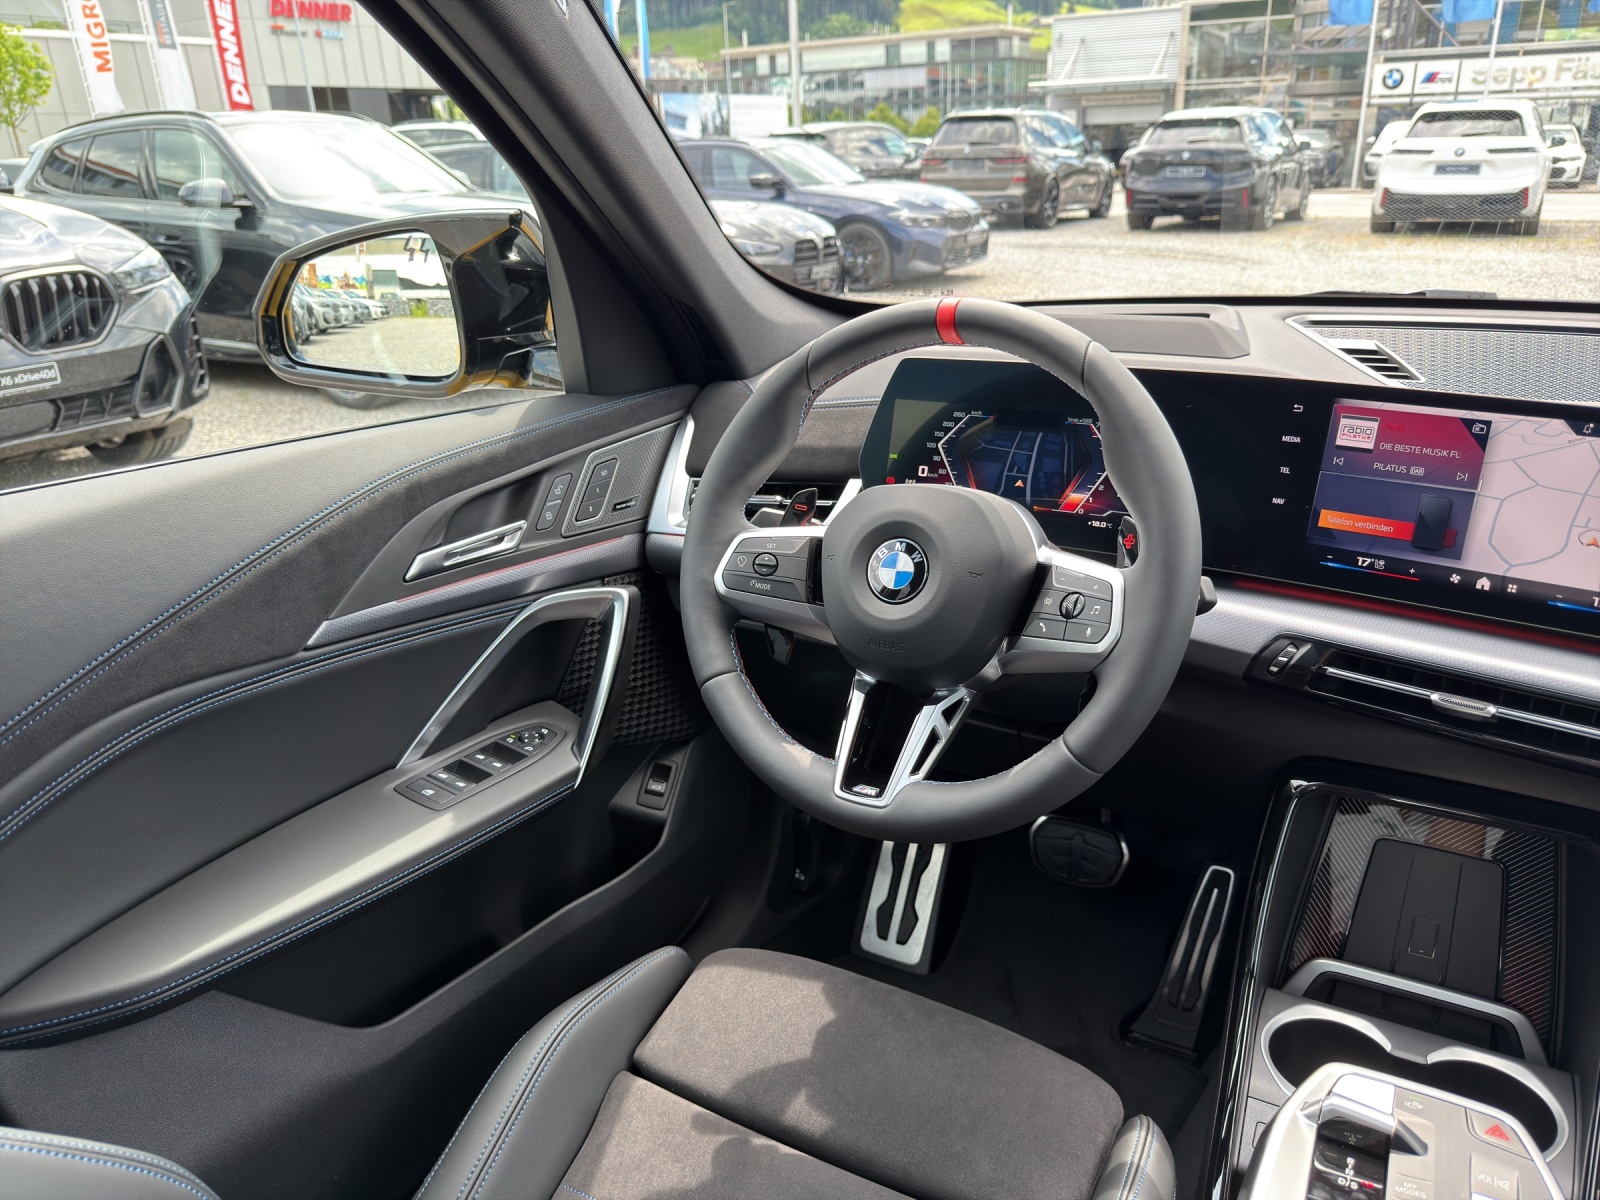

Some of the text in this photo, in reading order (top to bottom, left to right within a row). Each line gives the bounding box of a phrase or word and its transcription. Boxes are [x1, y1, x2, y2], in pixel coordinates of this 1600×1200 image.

[156, 0, 172, 45] RESTAUR
[82, 0, 113, 73] MIGR
[213, 0, 250, 105] DENNE
[1281, 435, 1301, 443] MEDIA
[1379, 442, 1394, 451] DIE
[1394, 444, 1421, 454] BESTE
[1422, 447, 1449, 458] MUSIK
[918, 465, 929, 477] 0
[1280, 466, 1290, 474] TEL
[1373, 462, 1407, 474] PILATUS
[1272, 497, 1285, 505] NAV
[1327, 515, 1394, 533] Telefon verbinden
[877, 541, 923, 563] BMW
[755, 583, 772, 591] MODE
[1476, 1171, 1493, 1183] VOL
[1403, 1181, 1418, 1189] MY
[1395, 1185, 1427, 1199] MODES
